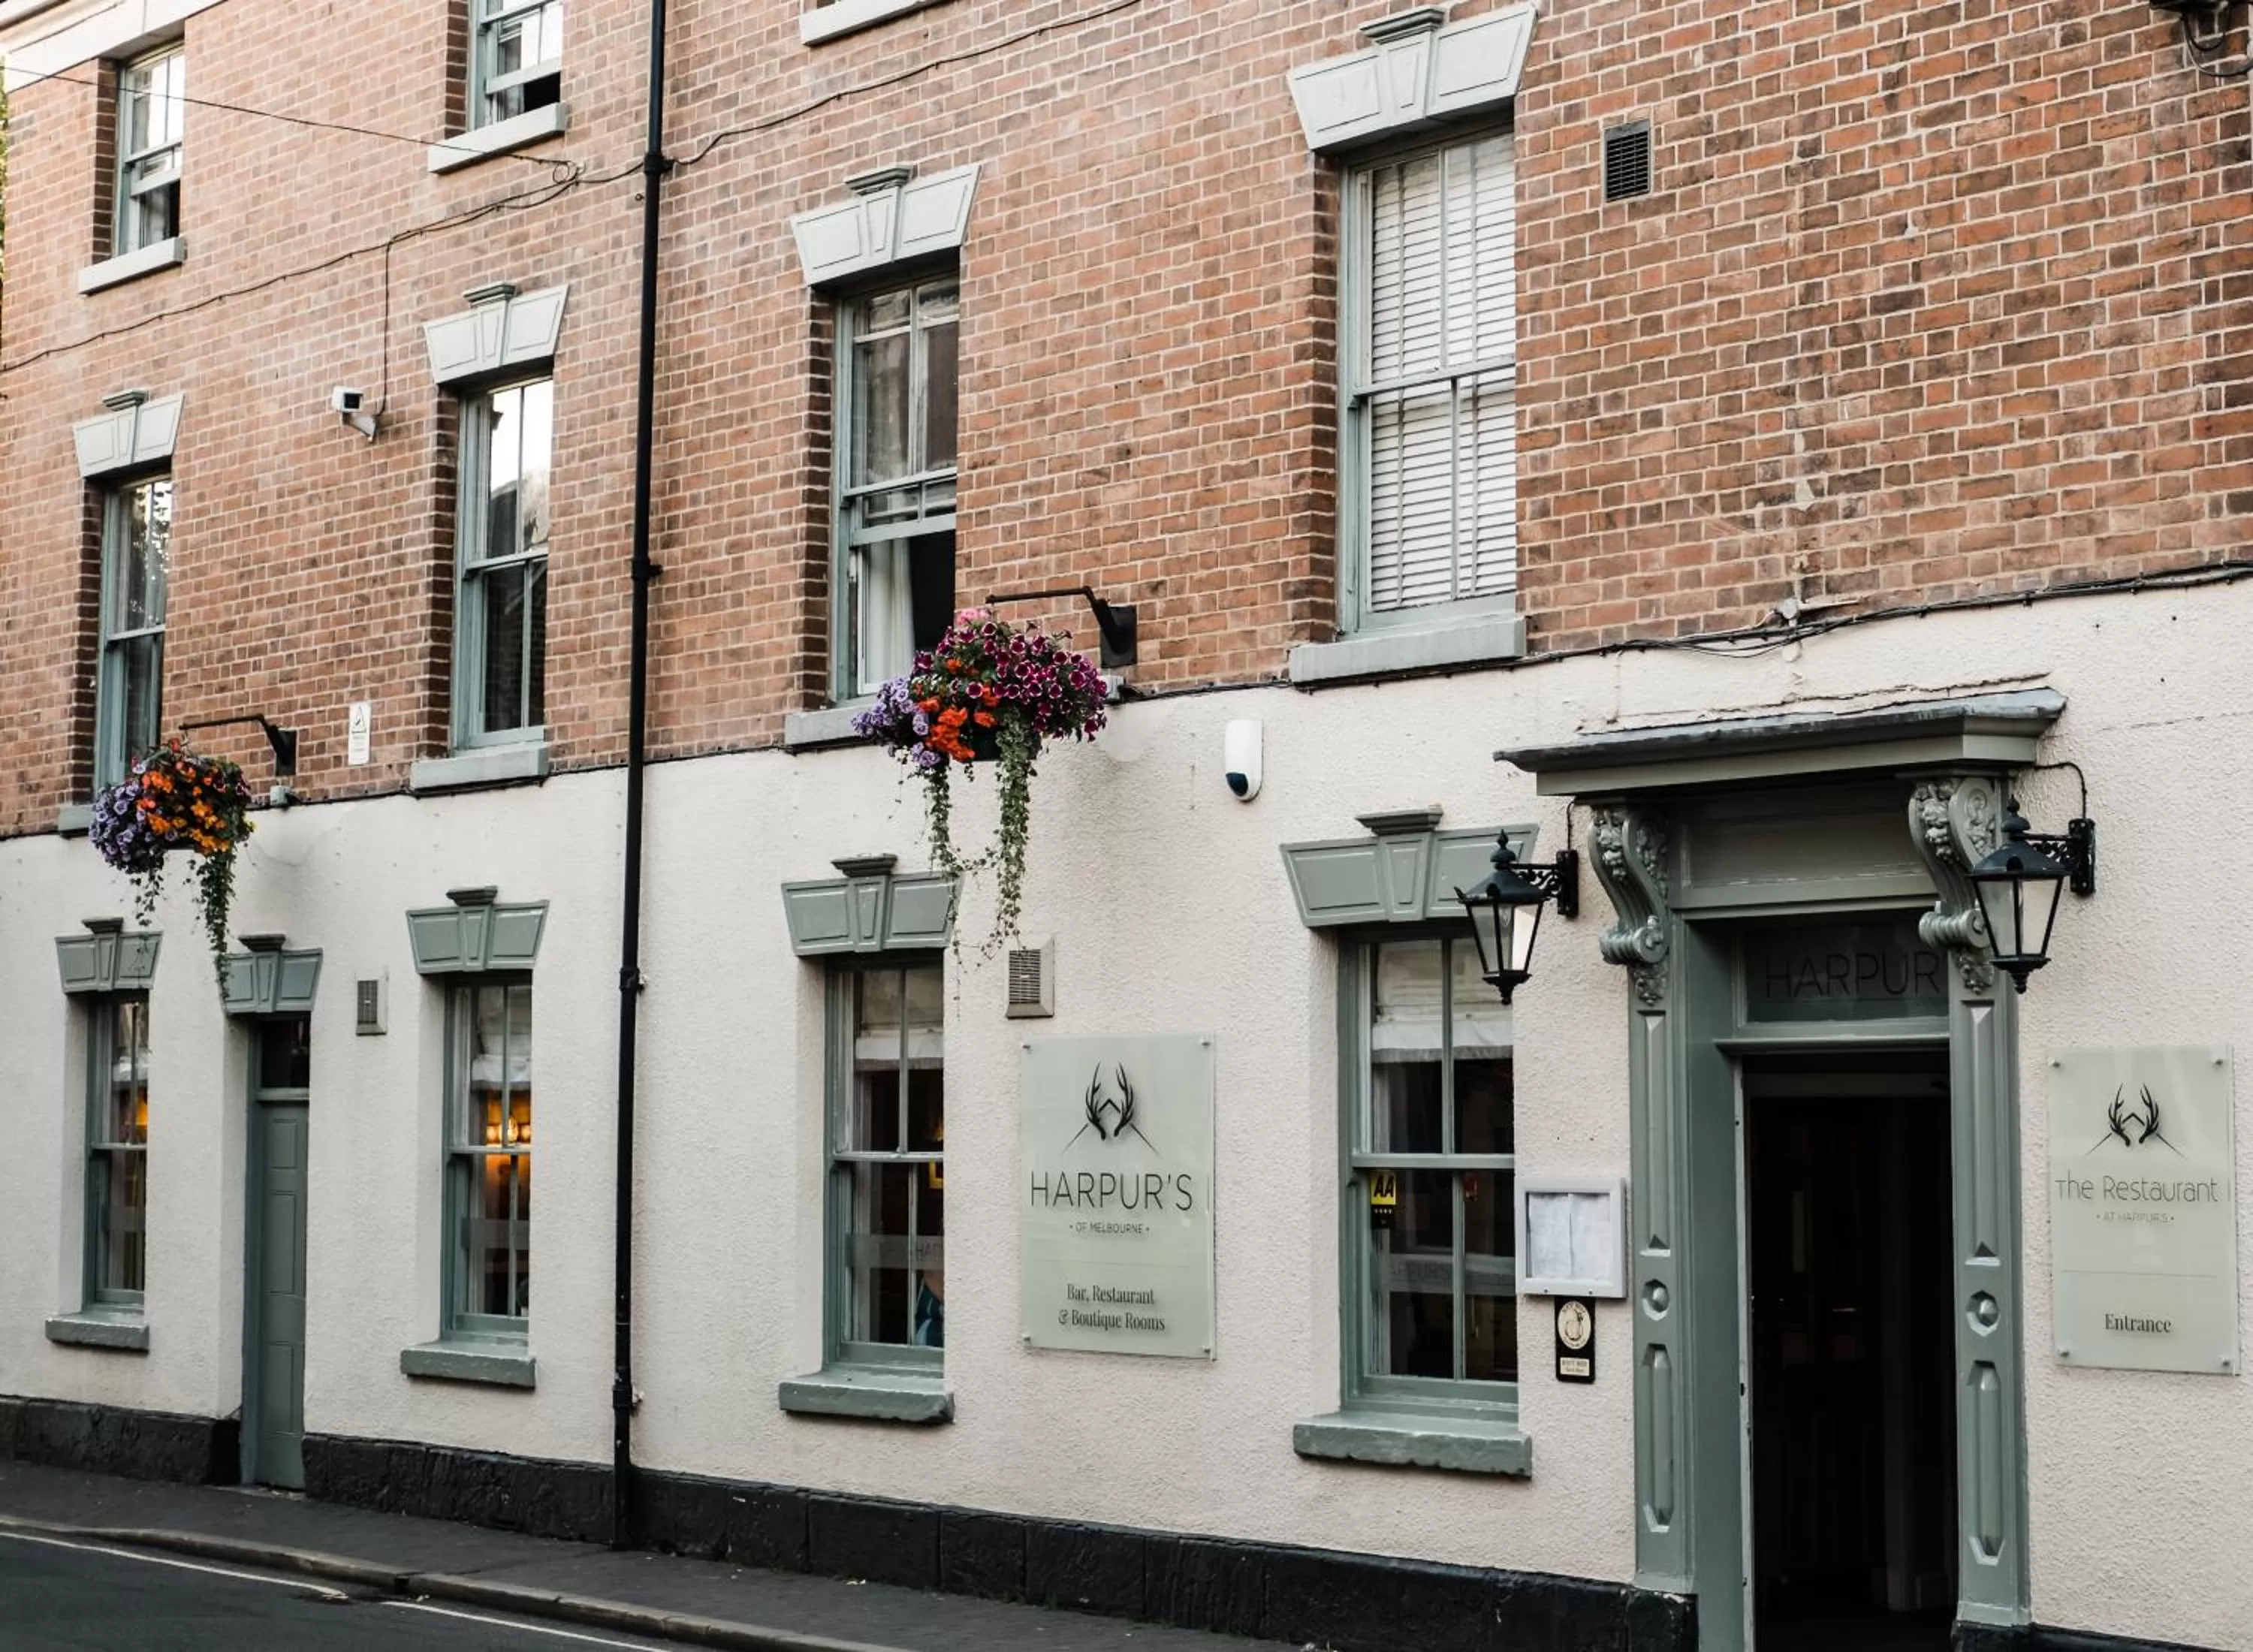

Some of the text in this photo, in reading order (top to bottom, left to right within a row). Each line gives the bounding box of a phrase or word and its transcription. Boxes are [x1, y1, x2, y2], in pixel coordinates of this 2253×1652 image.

[1765, 949, 1948, 999] HARPUR'
[1030, 1171, 1193, 1211] HARPUR'S
[1374, 1174, 1395, 1198] AA
[2055, 1168, 2219, 1202] The Restaurant
[1075, 1220, 1144, 1234] OF MELBOURNE
[1066, 1283, 1155, 1305] Bar, Restaurant
[1057, 1308, 1166, 1331] & Boutique Rooms
[2105, 1313, 2172, 1334] Entrance
